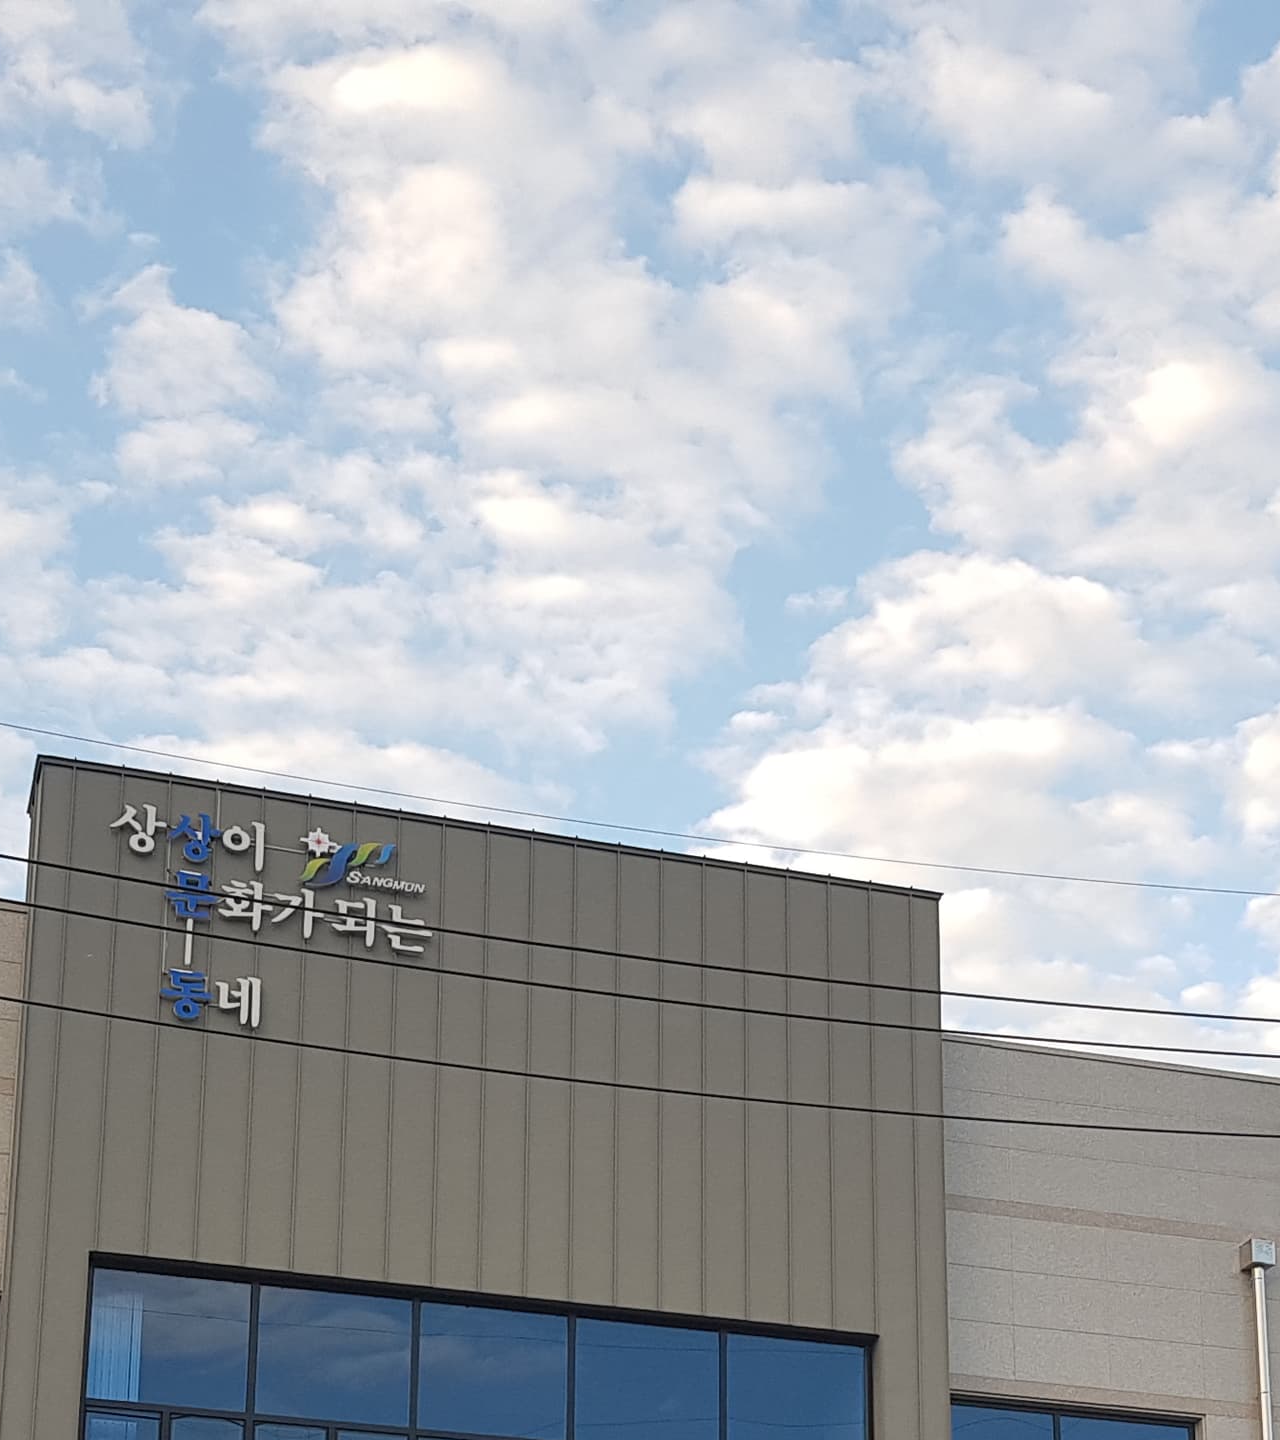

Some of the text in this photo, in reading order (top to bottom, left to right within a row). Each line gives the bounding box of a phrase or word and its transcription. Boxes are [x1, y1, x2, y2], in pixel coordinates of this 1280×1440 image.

[109, 802, 266, 873] 상상이
[346, 870, 426, 893] SANGMUN
[160, 968, 262, 1029] 동네
